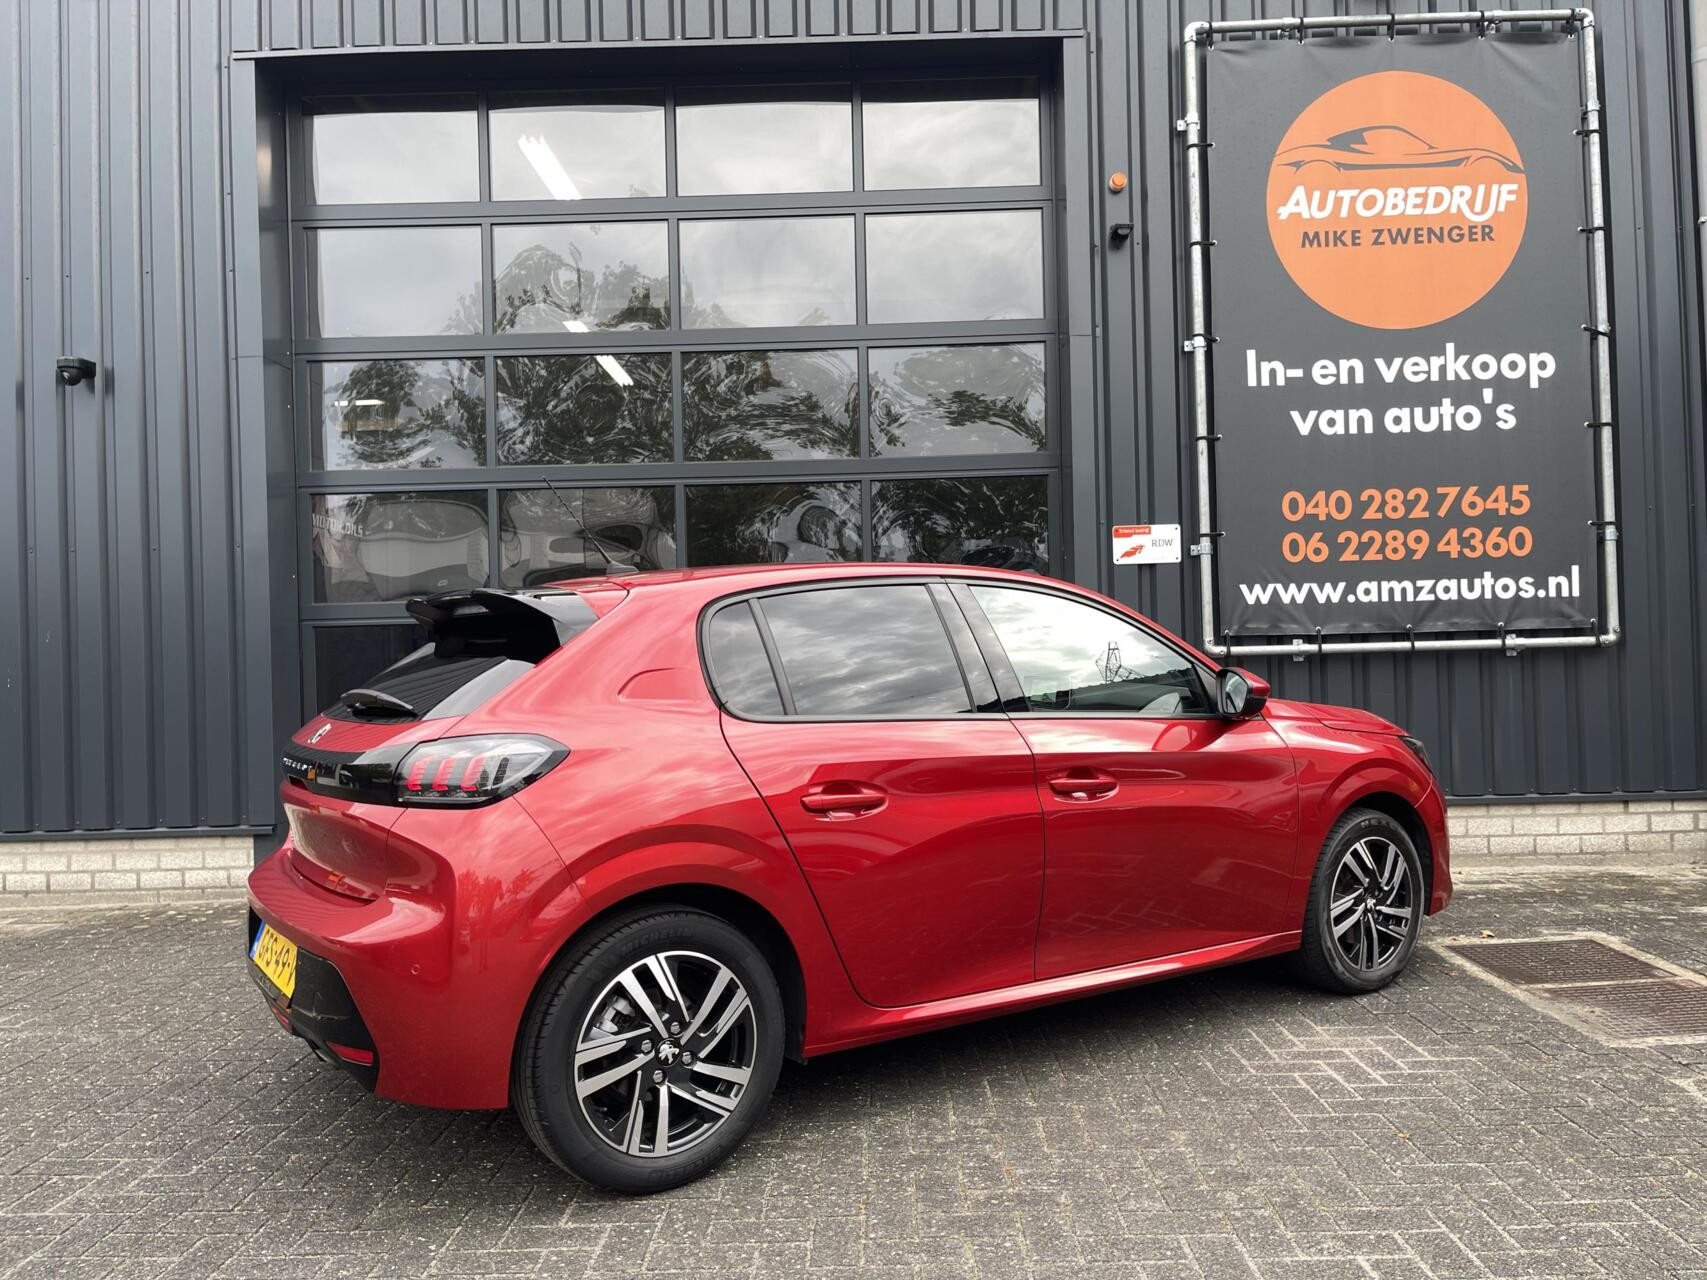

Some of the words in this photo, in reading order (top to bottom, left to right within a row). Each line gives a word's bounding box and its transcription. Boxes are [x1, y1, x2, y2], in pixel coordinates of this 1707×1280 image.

[1277, 183, 1518, 222] AUTOBEDRIJF
[1300, 229, 1362, 249] MIKE
[1371, 224, 1495, 247] ZWENGER
[1246, 349, 1304, 387] In-
[1312, 358, 1364, 385] en
[1374, 342, 1557, 389] verkoop
[1290, 409, 1373, 436] van
[1384, 388, 1517, 433] auto's
[1281, 490, 1352, 522] 040
[1360, 487, 1430, 520] 282
[1436, 484, 1531, 517] 7645
[1151, 538, 1173, 548] RDW
[1281, 532, 1329, 563] 06
[1337, 529, 1430, 562] 2289
[1437, 526, 1533, 559] 4360
[1239, 565, 1580, 605] www.amzautos.nl
